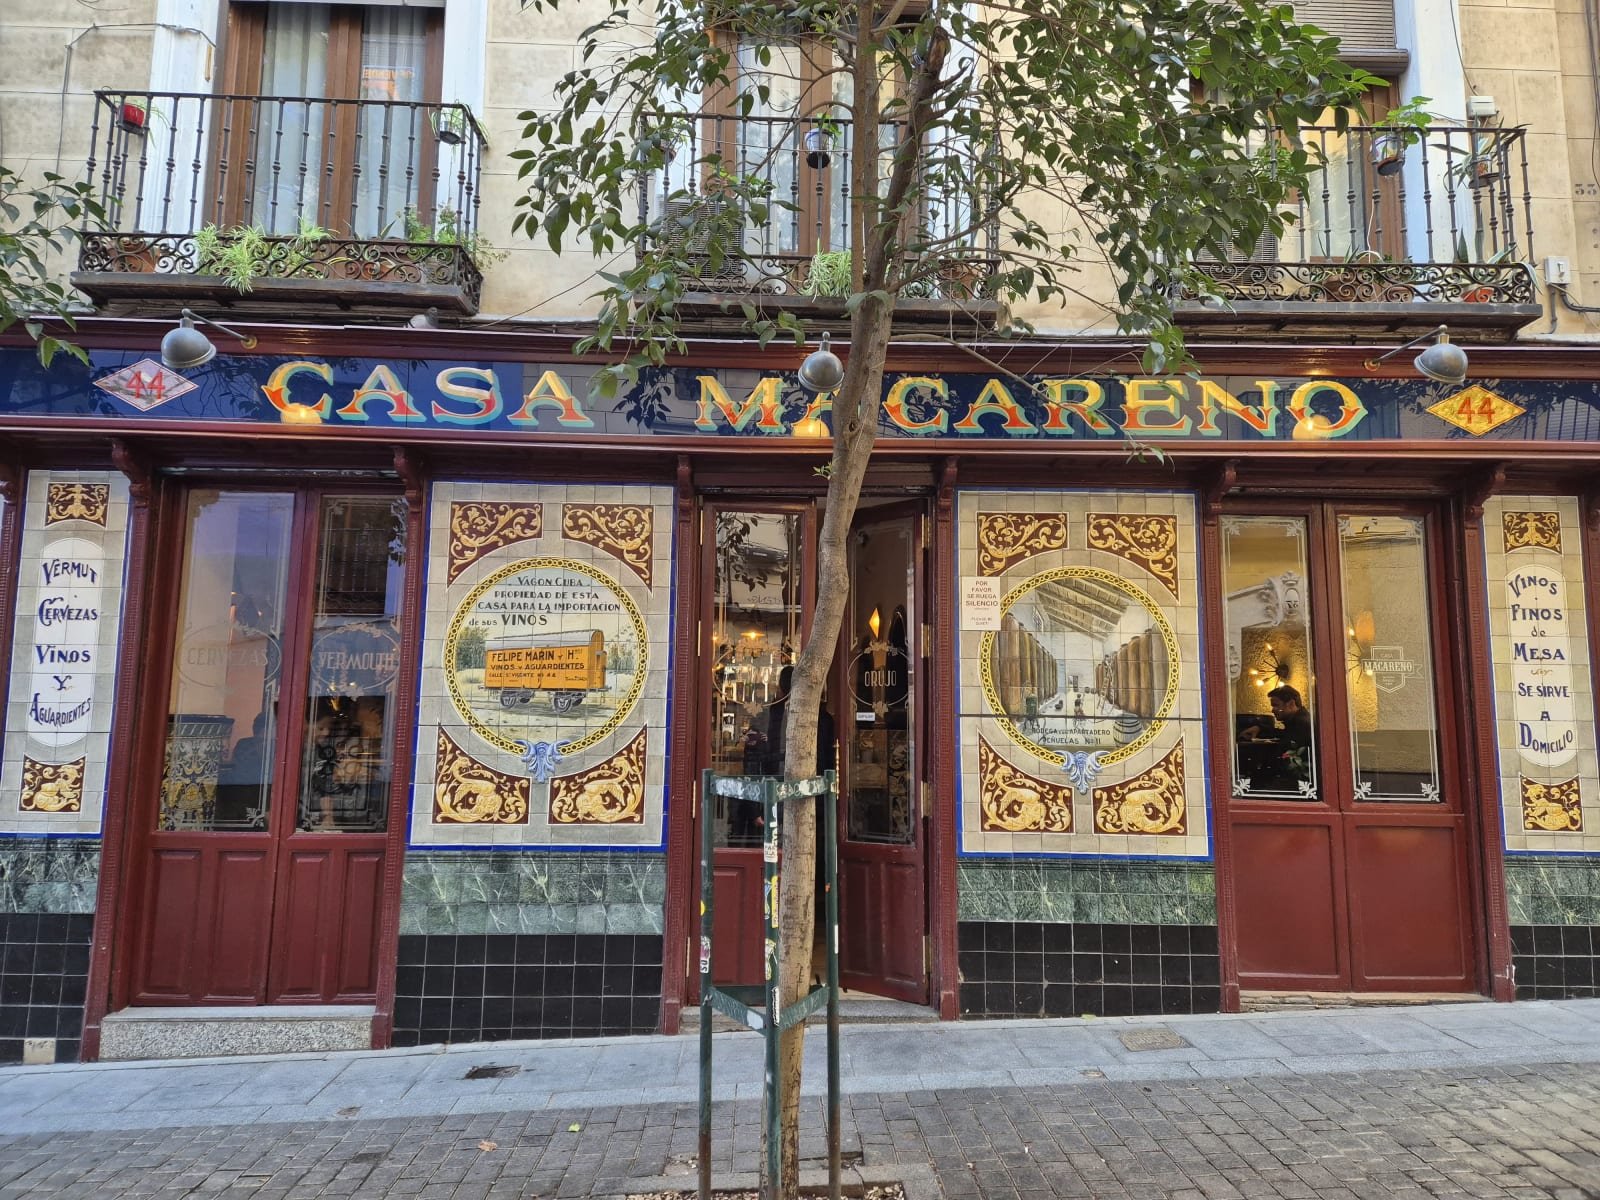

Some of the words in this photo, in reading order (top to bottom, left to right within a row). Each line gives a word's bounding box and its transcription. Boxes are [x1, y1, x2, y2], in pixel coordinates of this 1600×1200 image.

[125, 370, 166, 400] 44
[262, 360, 595, 429] CASA
[1456, 396, 1496, 425] 44
[42, 558, 97, 585] VERMUT
[555, 577, 583, 587] CUBA
[1508, 573, 1558, 598] VINOS
[494, 590, 552, 599] PROPIEDAD
[555, 591, 568, 599] DE
[572, 591, 599, 599] ESTA
[39, 596, 98, 626] CERVEZAS
[477, 601, 507, 610] CASA
[510, 602, 535, 611] PARA
[538, 602, 551, 611] LA
[554, 602, 621, 611] IMPORTACION
[1511, 603, 1563, 621] FINOS
[501, 614, 548, 626] VINOS
[1530, 626, 1546, 637] de
[35, 645, 91, 664] VINOS
[492, 651, 522, 661] FELIPE
[525, 650, 554, 661] MARIN
[1513, 642, 1565, 662] MESA
[318, 651, 395, 671] VERMOUTH
[524, 662, 585, 670] AGUARDIENTES
[1363, 660, 1413, 672] MACARENO
[52, 675, 72, 691] Y
[864, 670, 897, 687] ORUJO
[1518, 682, 1534, 697] SE
[1536, 683, 1570, 698] SIRVE
[29, 692, 91, 727] AGUARDIENTES
[1540, 711, 1551, 721] A
[1519, 722, 1574, 754] DOMICILIO
